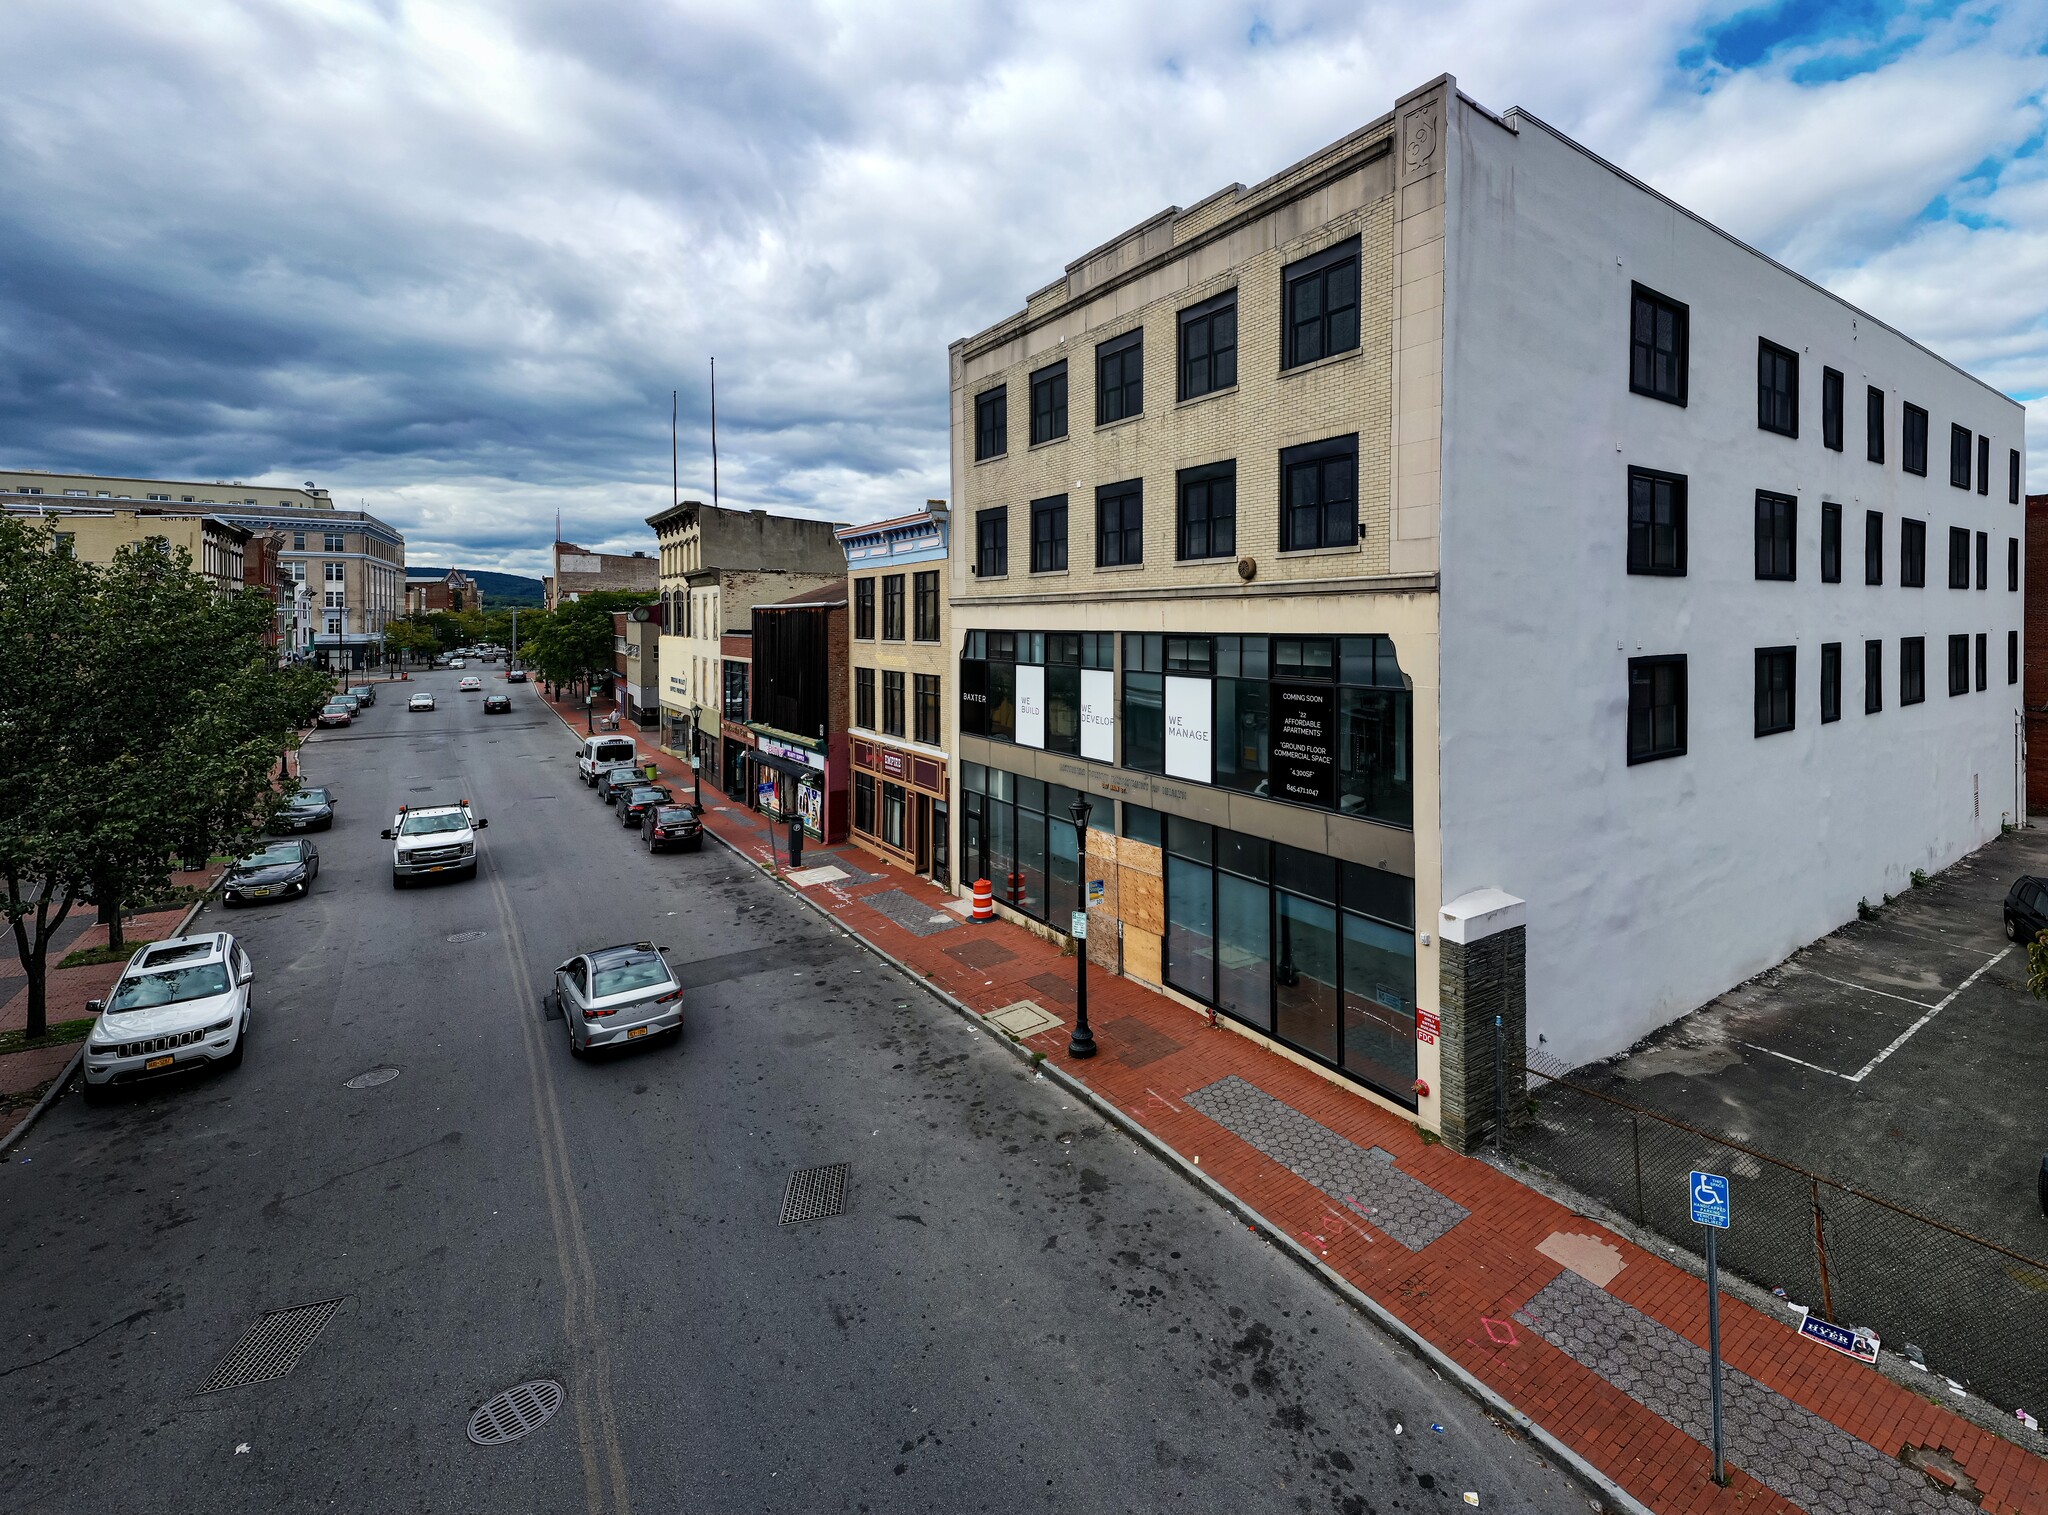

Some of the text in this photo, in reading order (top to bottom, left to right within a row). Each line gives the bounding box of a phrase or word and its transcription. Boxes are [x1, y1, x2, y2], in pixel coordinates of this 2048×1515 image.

[963, 692, 987, 704] BAXTER
[1021, 697, 1031, 705] WE
[1282, 693, 1323, 703] COMING SOON
[1021, 705, 1040, 716] BUILD
[1081, 704, 1092, 714] WE
[1168, 715, 1183, 726] WE
[1284, 718, 1321, 728] AFFORDABLE
[1168, 726, 1209, 742] MANAGE
[1274, 749, 1311, 761] COMMERCIAL
[1306, 745, 1327, 755] FLOOR
[1418, 1031, 1432, 1044] FDC
[1693, 1202, 1727, 1213] HANDICAPPED
[1700, 1207, 1721, 1216] PARKING
[1697, 1217, 1723, 1226] REQUIRED
